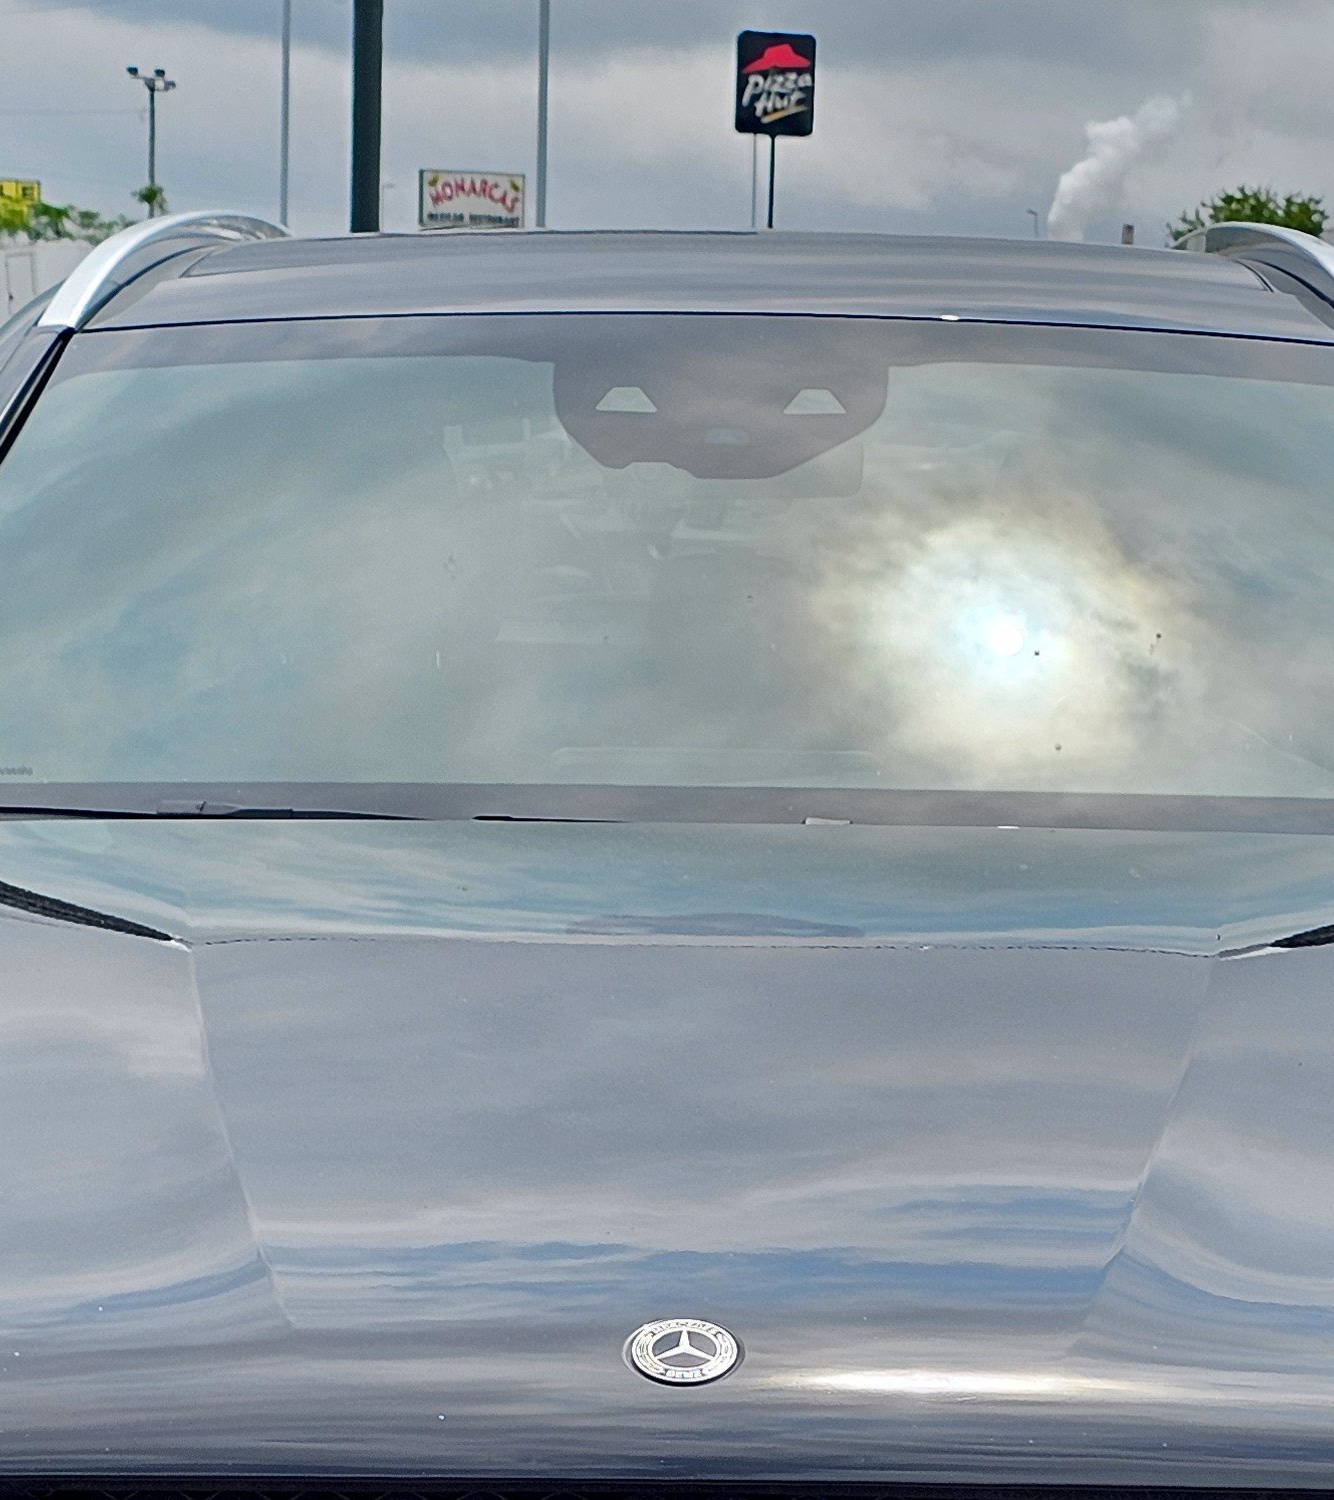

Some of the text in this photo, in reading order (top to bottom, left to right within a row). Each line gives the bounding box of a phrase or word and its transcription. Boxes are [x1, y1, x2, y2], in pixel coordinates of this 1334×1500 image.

[742, 70, 812, 107] Pizza
[754, 91, 807, 117] Hut
[429, 177, 520, 214] MONARCAS
